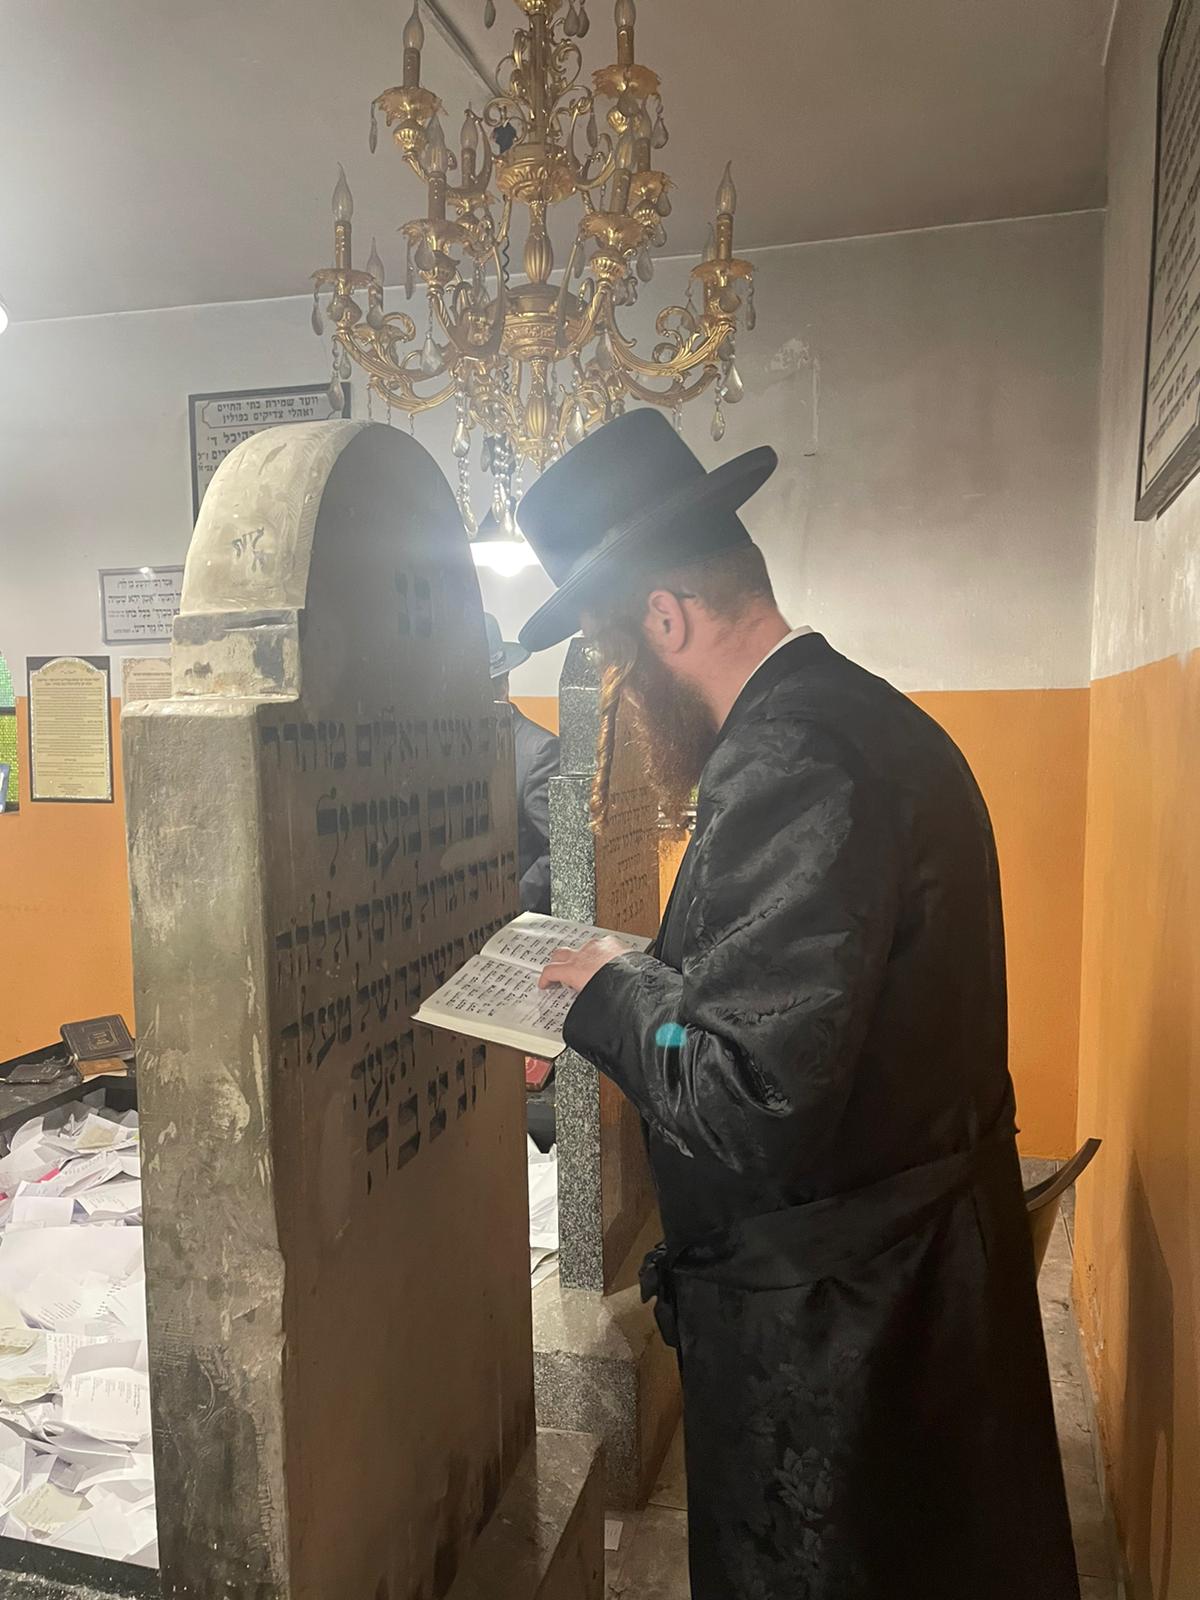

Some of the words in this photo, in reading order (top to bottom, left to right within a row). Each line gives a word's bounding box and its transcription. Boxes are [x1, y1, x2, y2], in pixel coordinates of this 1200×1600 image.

[266, 399, 294, 408] שמירת
[254, 411, 283, 421] צדיקים
[289, 408, 314, 417] ואהלי
[223, 413, 249, 423] בפולין
[428, 780, 490, 846] מנחם
[316, 786, 421, 880] מענדיל
[279, 986, 351, 1071] מעלה
